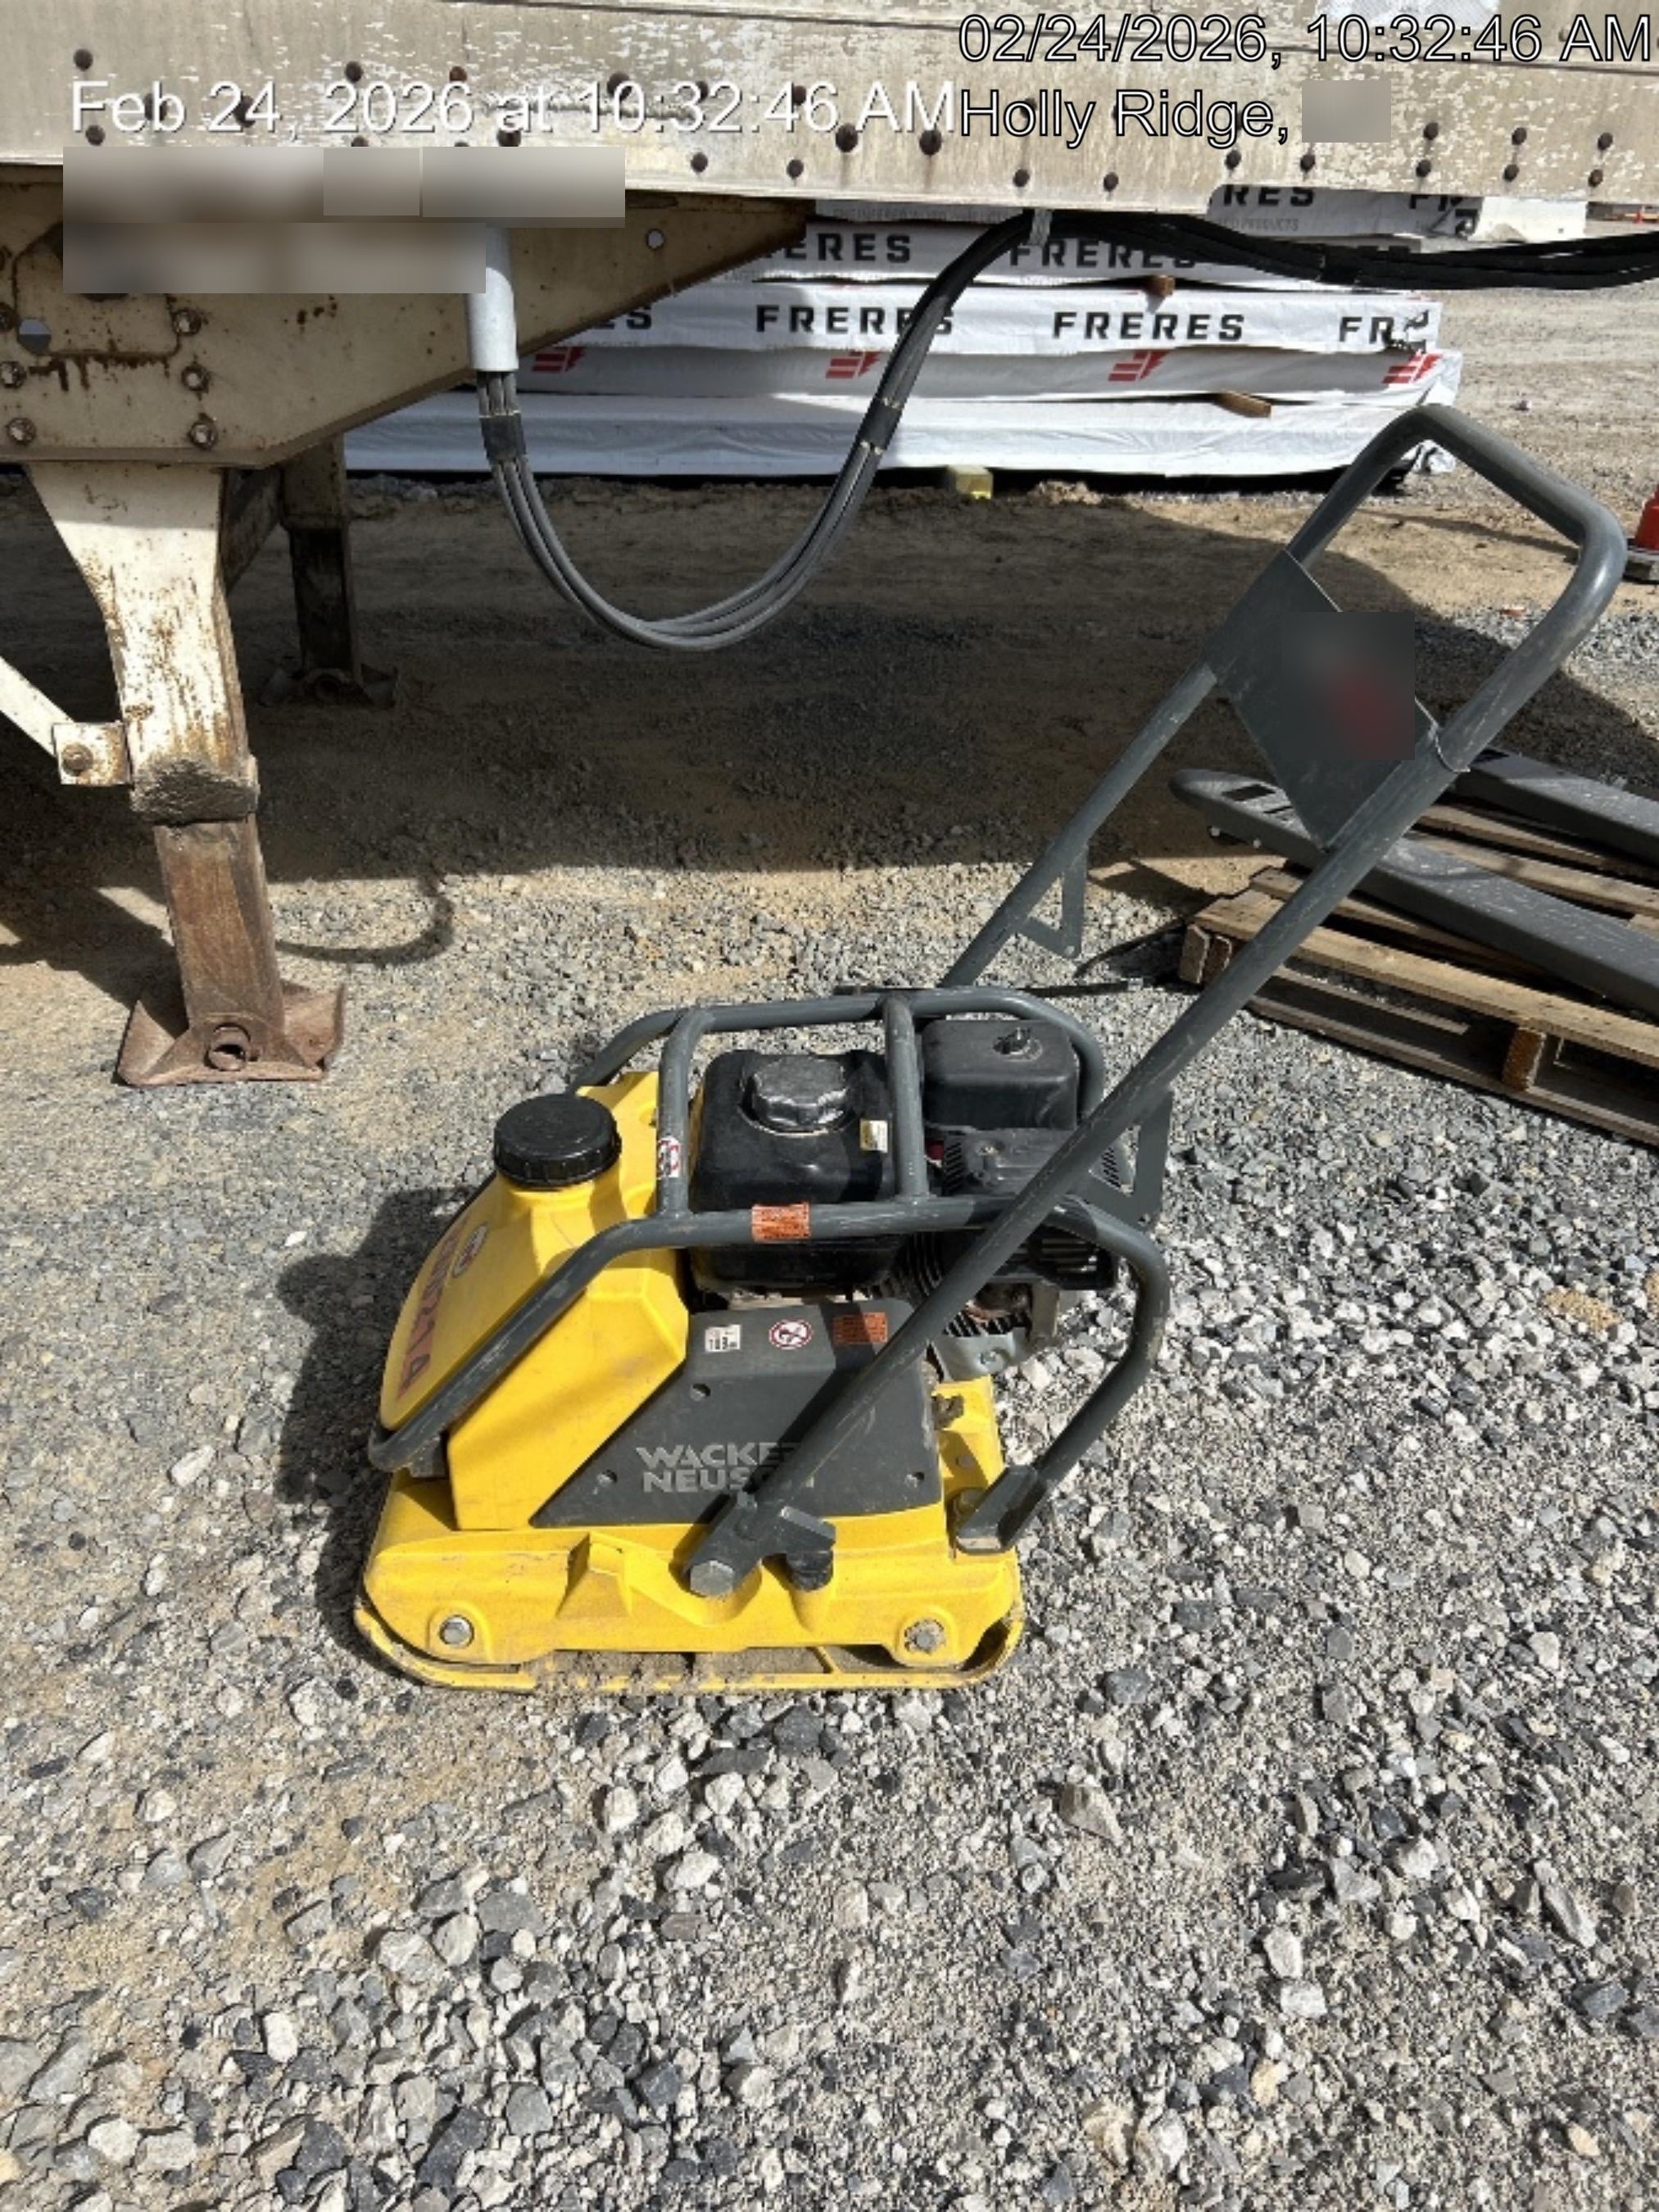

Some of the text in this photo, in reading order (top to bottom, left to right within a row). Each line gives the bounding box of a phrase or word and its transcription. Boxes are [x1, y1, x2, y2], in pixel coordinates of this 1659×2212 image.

[1052, 311, 1245, 342] FRERES
[635, 1442, 797, 1470] WACKE
[643, 1466, 814, 1493] NEUS
